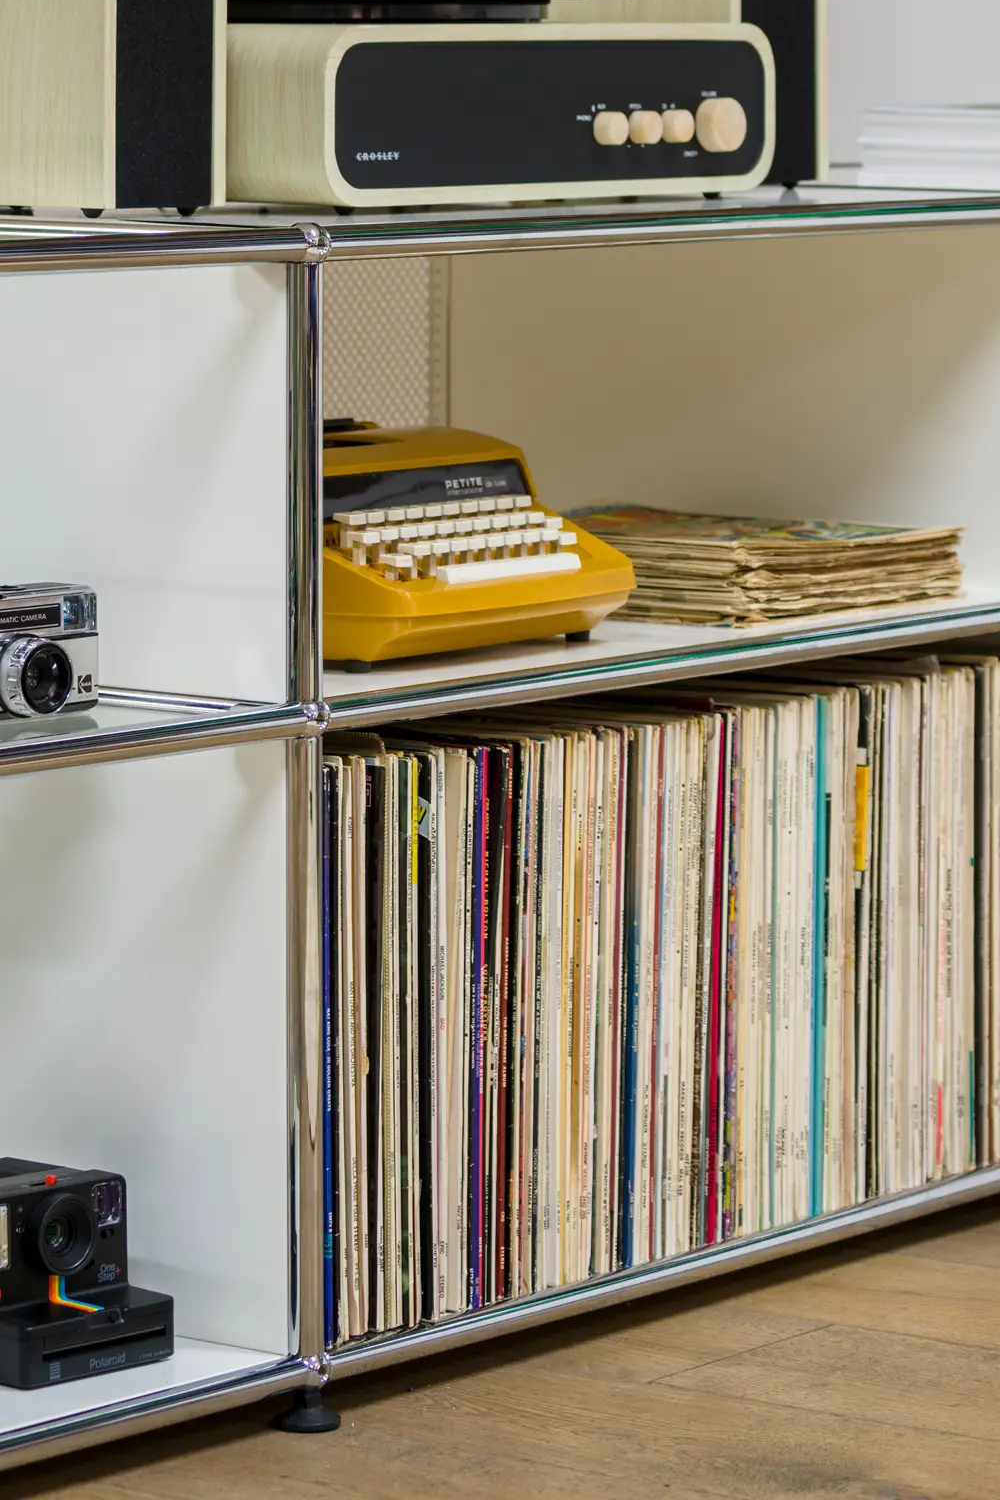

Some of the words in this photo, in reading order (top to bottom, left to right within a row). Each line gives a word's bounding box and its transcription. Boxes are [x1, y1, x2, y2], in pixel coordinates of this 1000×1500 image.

[356, 151, 400, 161] CROSLEY
[444, 477, 483, 490] PETITE
[20, 613, 47, 622] CAMERA
[100, 1263, 115, 1273] One
[98, 1271, 115, 1282] Step
[89, 1352, 126, 1369] Polaroid
